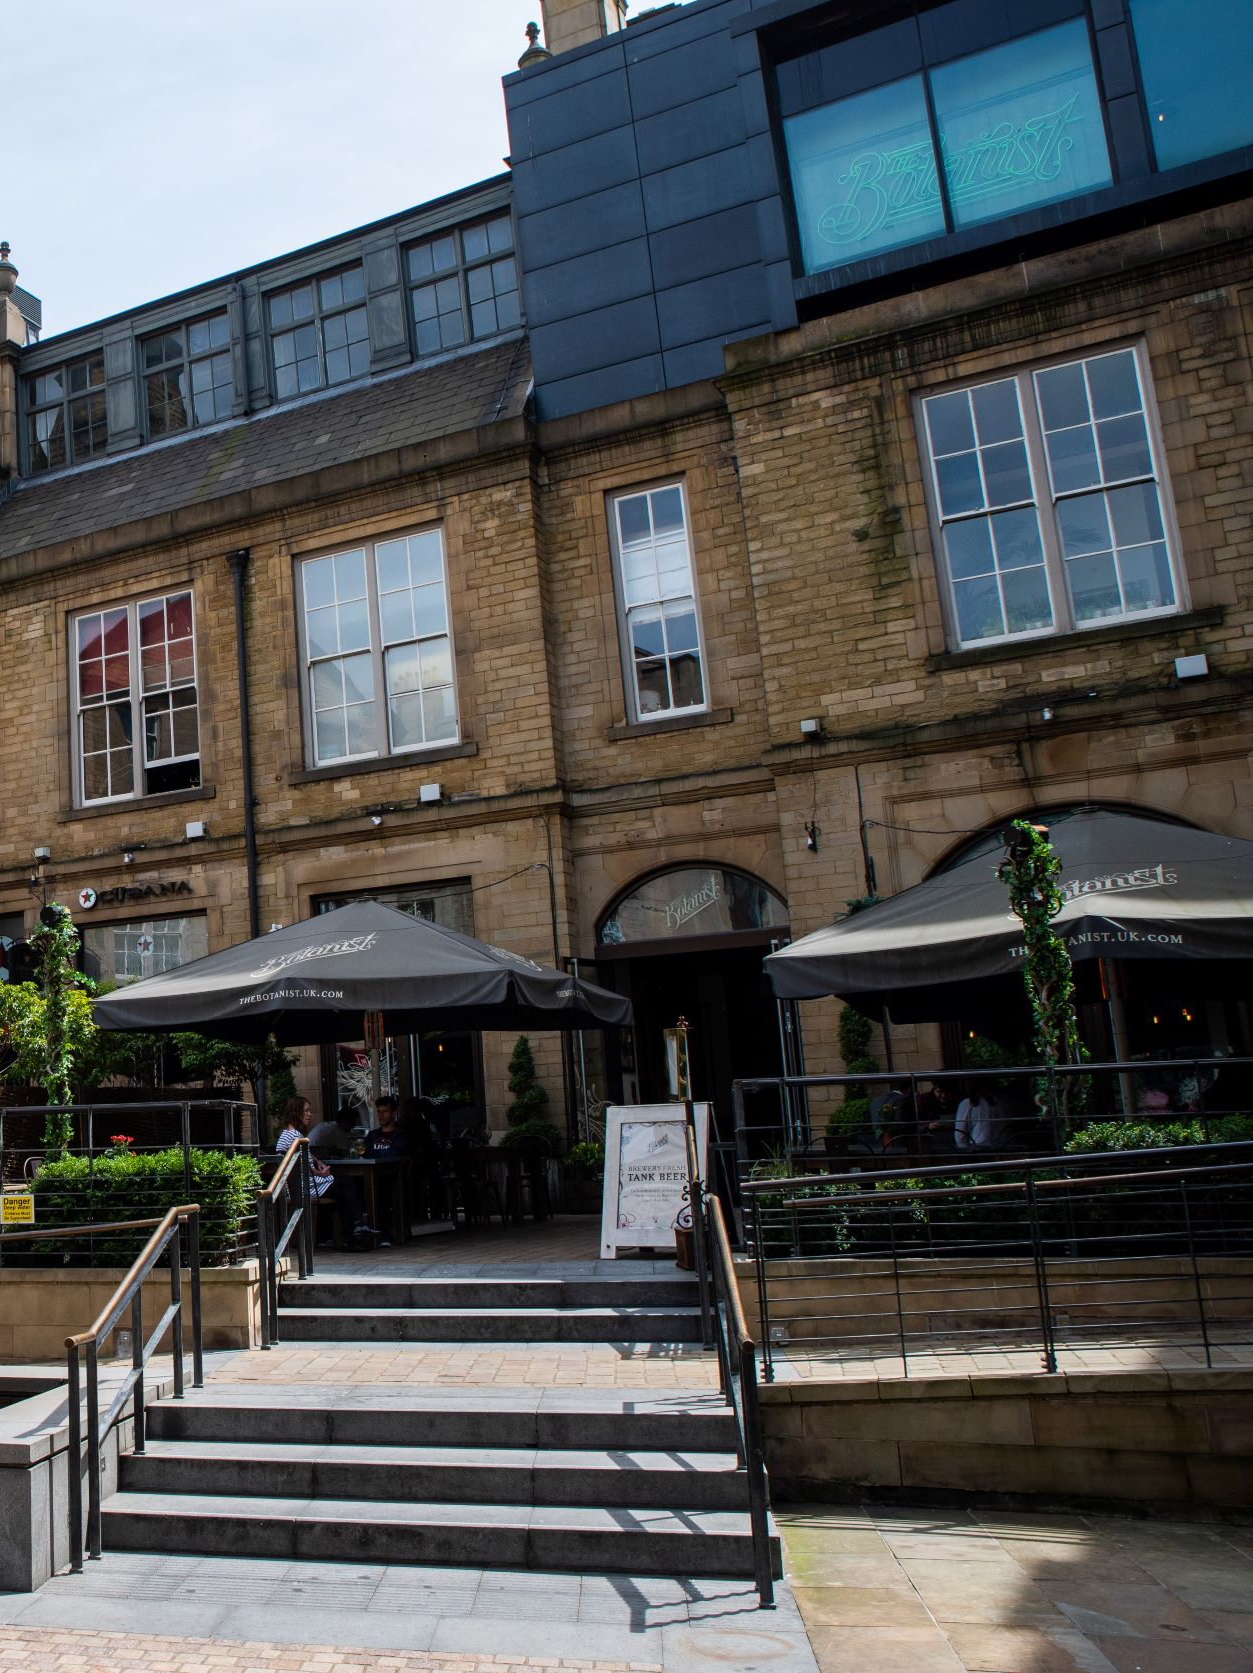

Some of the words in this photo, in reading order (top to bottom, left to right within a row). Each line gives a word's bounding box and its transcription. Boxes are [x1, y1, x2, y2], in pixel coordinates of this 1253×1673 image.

[817, 91, 1084, 244] Botanist
[99, 881, 193, 904] CUBANA
[666, 873, 721, 930] Botanist
[250, 931, 380, 978] Botanist
[1009, 932, 1183, 957] THANIST.UK.COM
[239, 989, 344, 1005] THEBOTANIST.UK.COM
[627, 1173, 656, 1182] TANK
[659, 1172, 687, 1181] BEER
[3, 1197, 31, 1207] Danger
